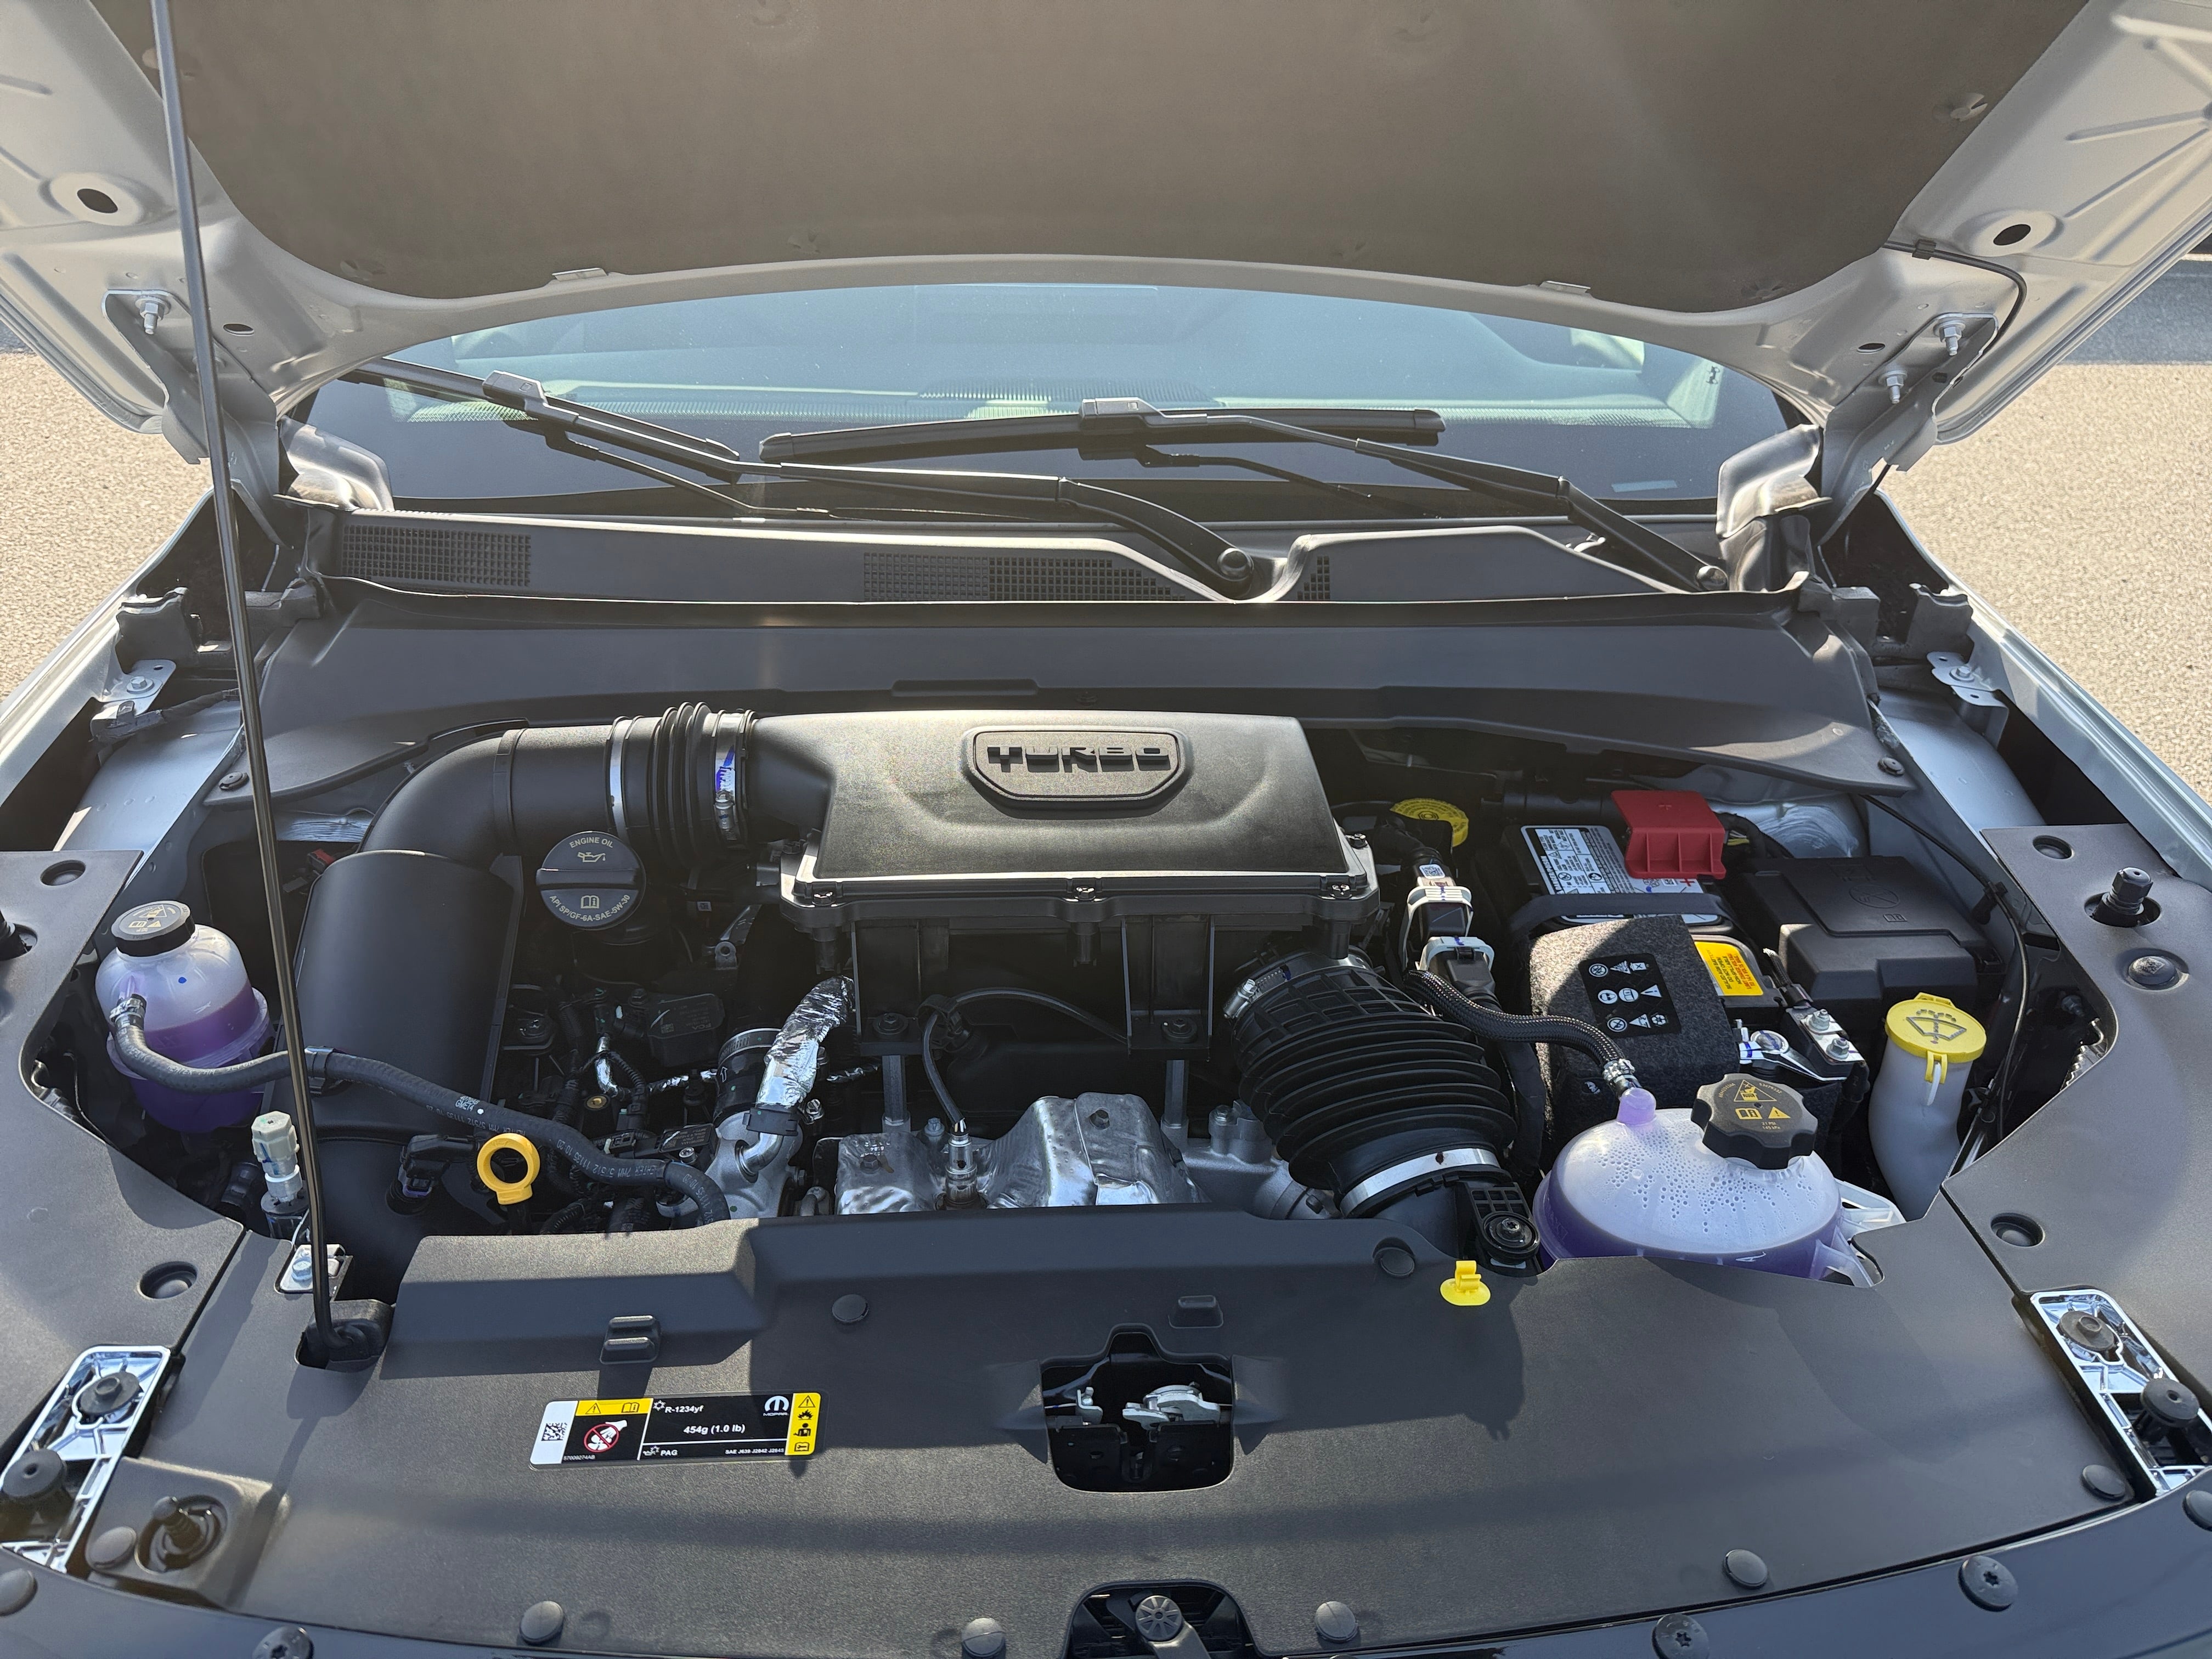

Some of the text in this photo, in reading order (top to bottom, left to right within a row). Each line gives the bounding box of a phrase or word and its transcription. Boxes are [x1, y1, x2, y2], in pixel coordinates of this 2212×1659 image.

[987, 746, 1171, 772] TURBO
[569, 837, 614, 848] ENGINE OIL
[549, 895, 561, 907] API
[573, 1152, 591, 1170] 11135
[592, 1164, 615, 1178] 57512
[665, 1405, 704, 1414] R-1234yf
[684, 1424, 746, 1435] 454g (1.0 lb)
